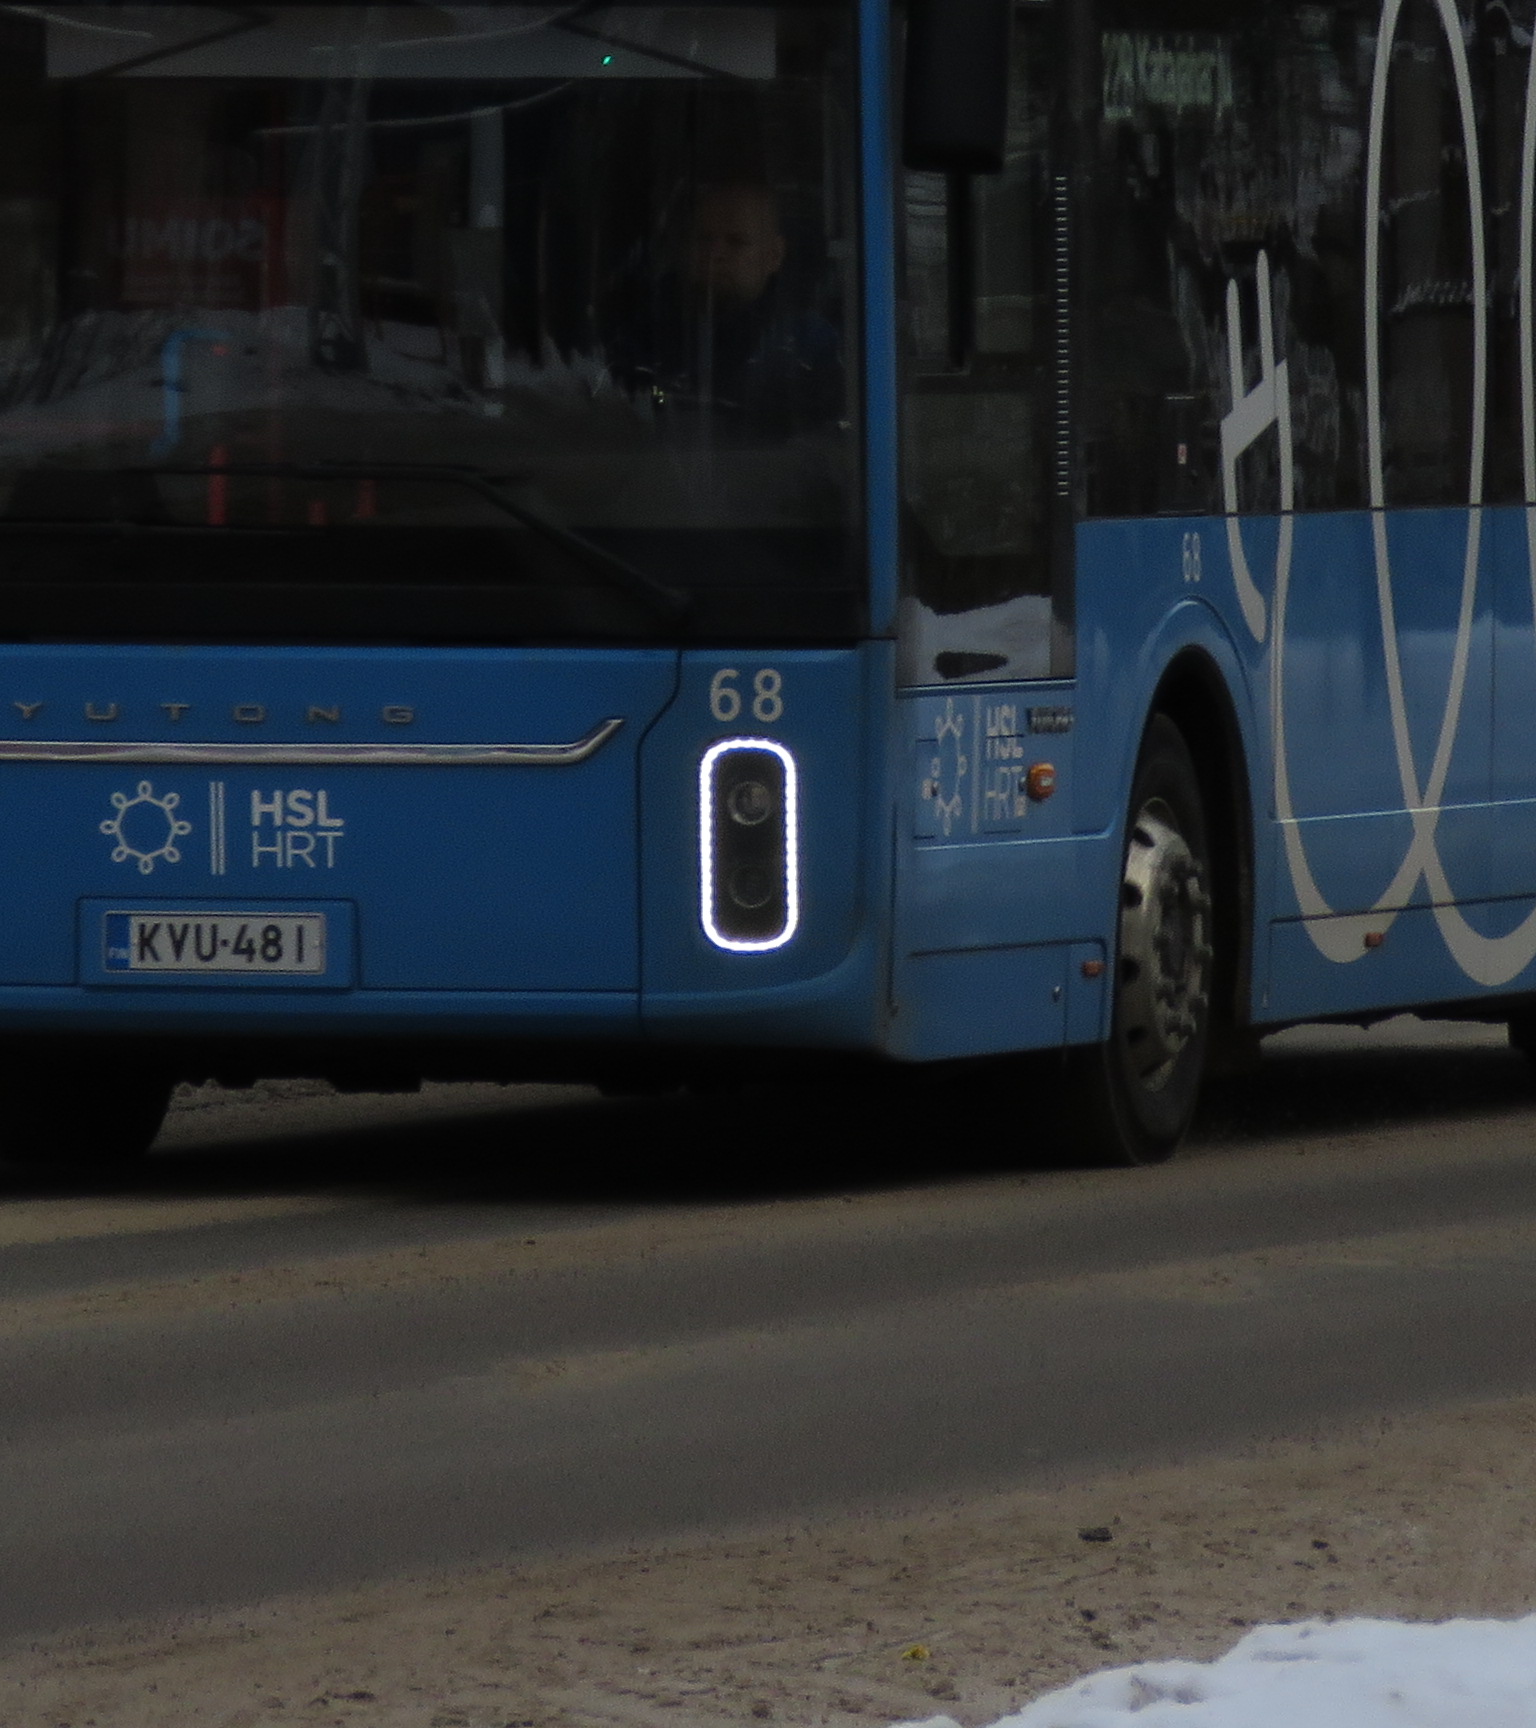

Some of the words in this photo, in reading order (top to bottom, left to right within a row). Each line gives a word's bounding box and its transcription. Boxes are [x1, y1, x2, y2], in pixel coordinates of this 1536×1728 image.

[13, 700, 416, 724] YUTONG
[709, 668, 784, 723] 68
[250, 789, 346, 827] HSL
[251, 830, 346, 869] HRT
[135, 922, 307, 963] KVU-481
